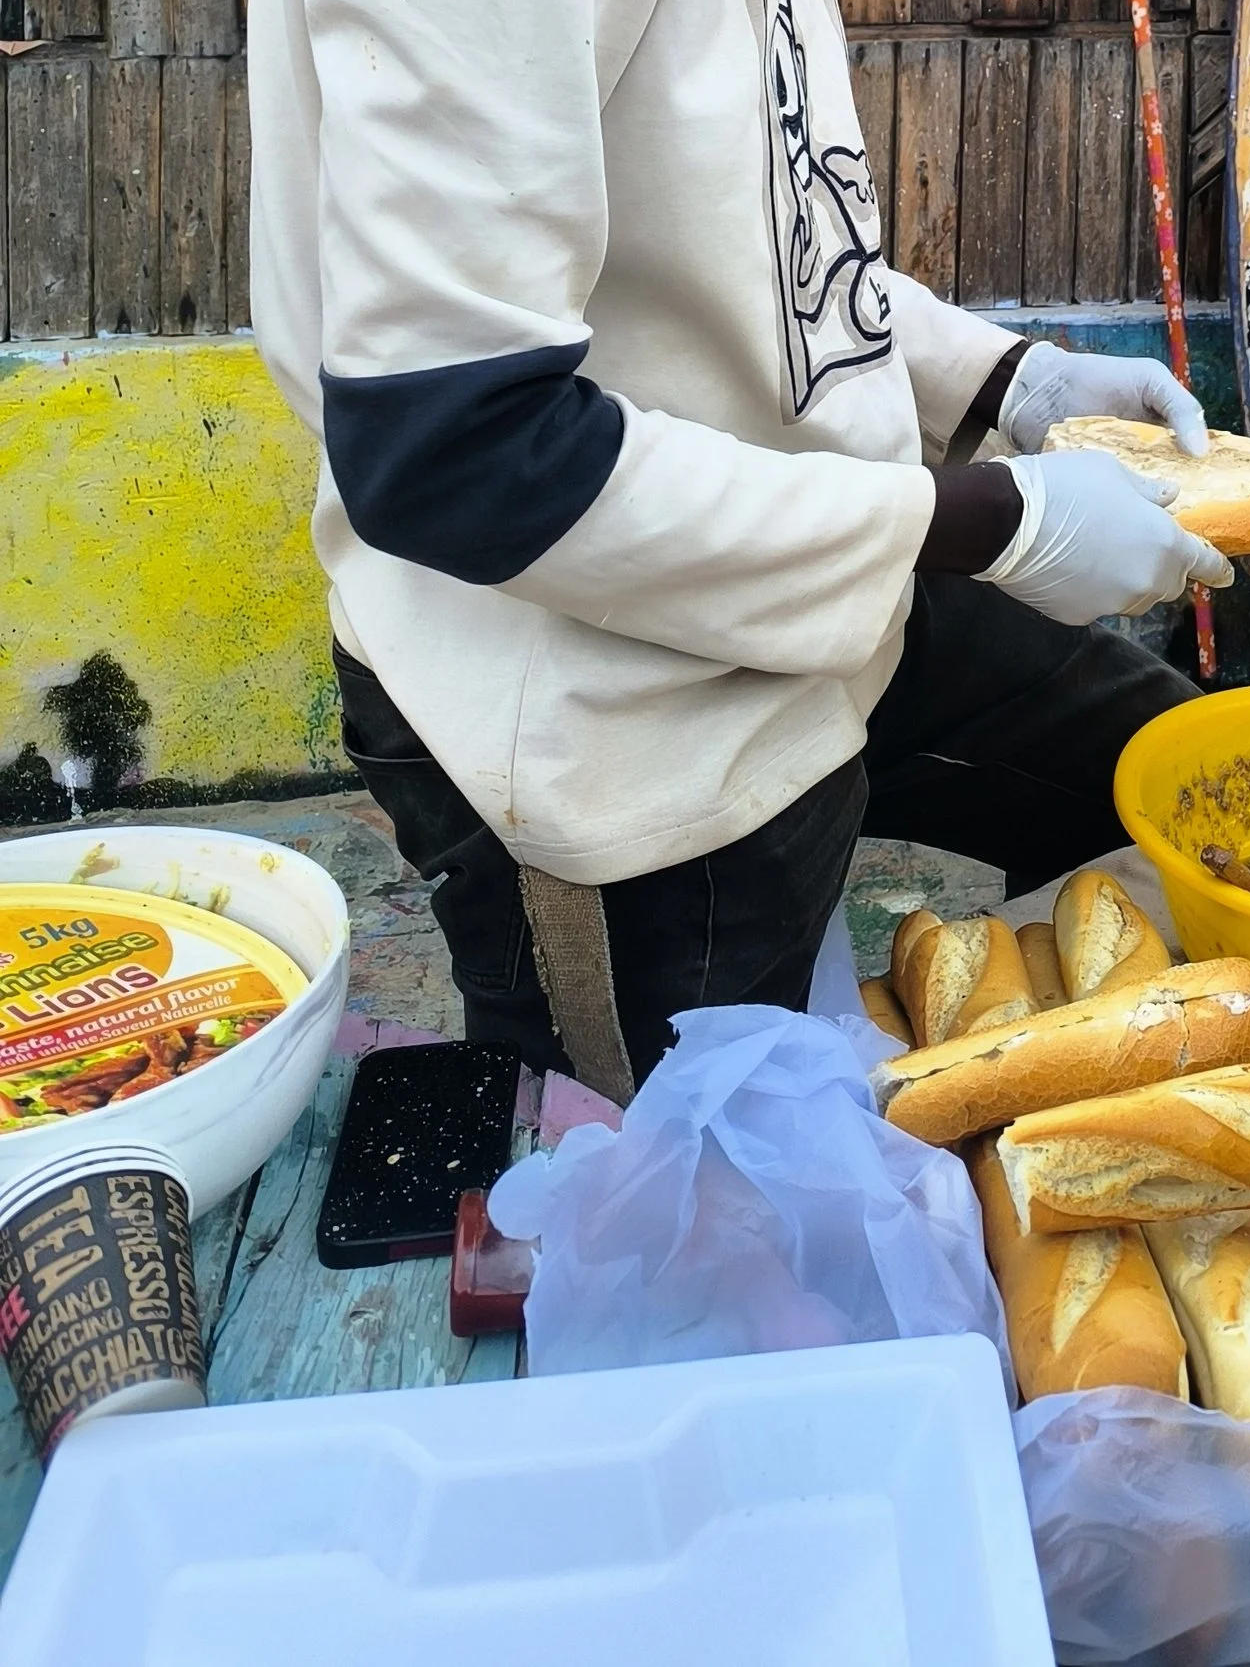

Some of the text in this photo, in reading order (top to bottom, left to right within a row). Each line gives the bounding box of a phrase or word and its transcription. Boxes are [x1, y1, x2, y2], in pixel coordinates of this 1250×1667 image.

[7, 965, 158, 1023] Lions
[65, 996, 163, 1039] natural
[169, 975, 240, 1016] flavor
[161, 995, 233, 1022] Naturelle
[18, 1185, 104, 1305] TEA
[106, 1175, 172, 1322] ESPRESSO
